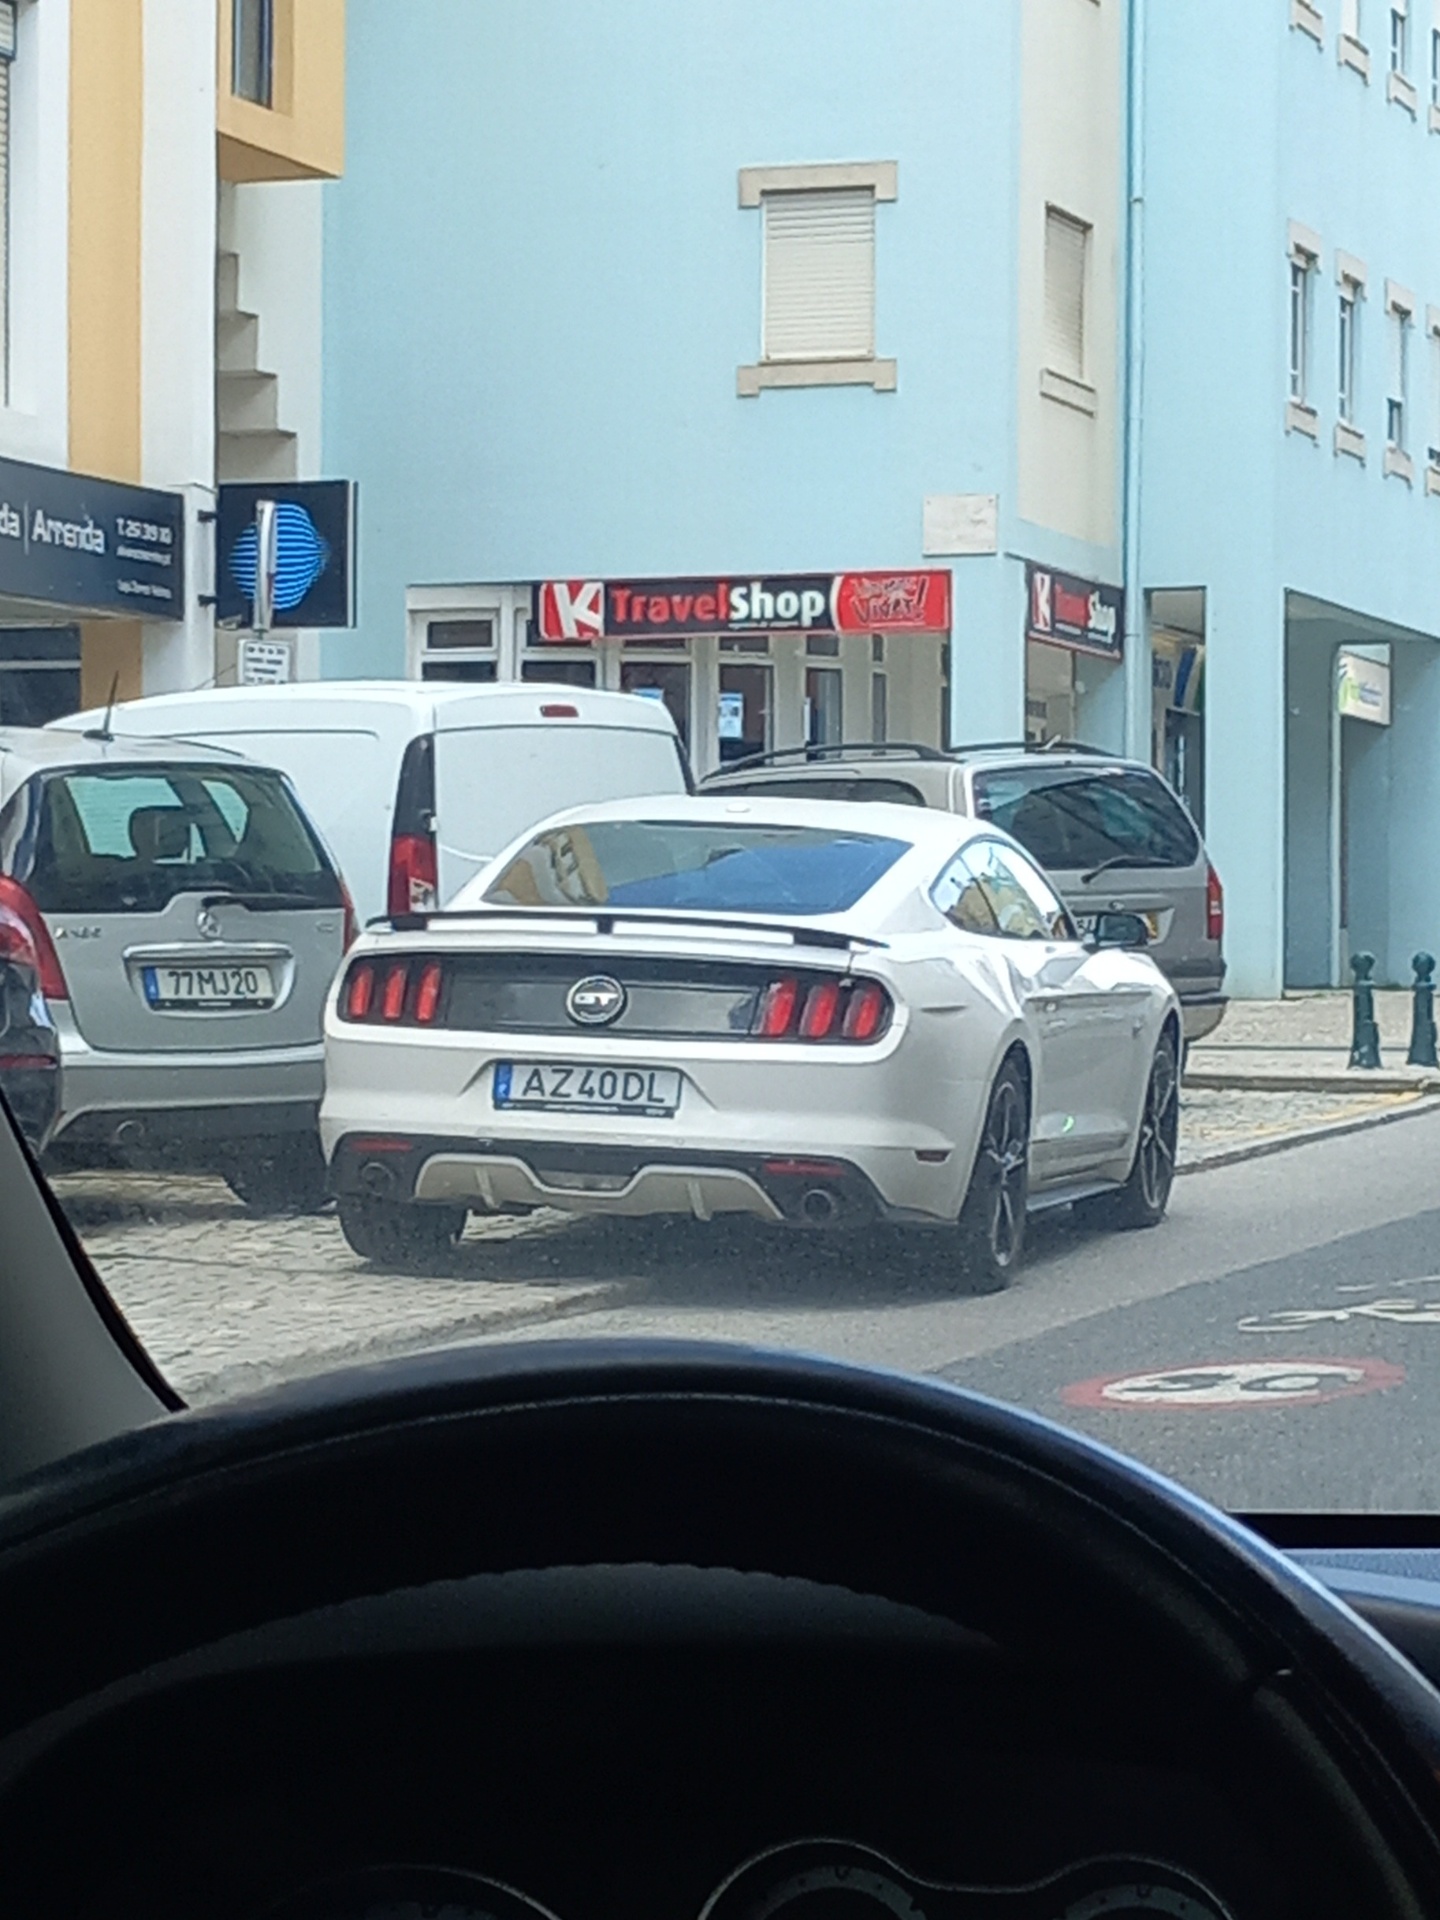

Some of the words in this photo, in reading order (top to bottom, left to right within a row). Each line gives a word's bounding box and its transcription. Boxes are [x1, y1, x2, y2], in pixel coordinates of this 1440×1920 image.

[553, 582, 601, 638] K
[168, 970, 259, 996] 77MJ20
[574, 992, 619, 1007] GT
[521, 1067, 665, 1103] AZ40DL
